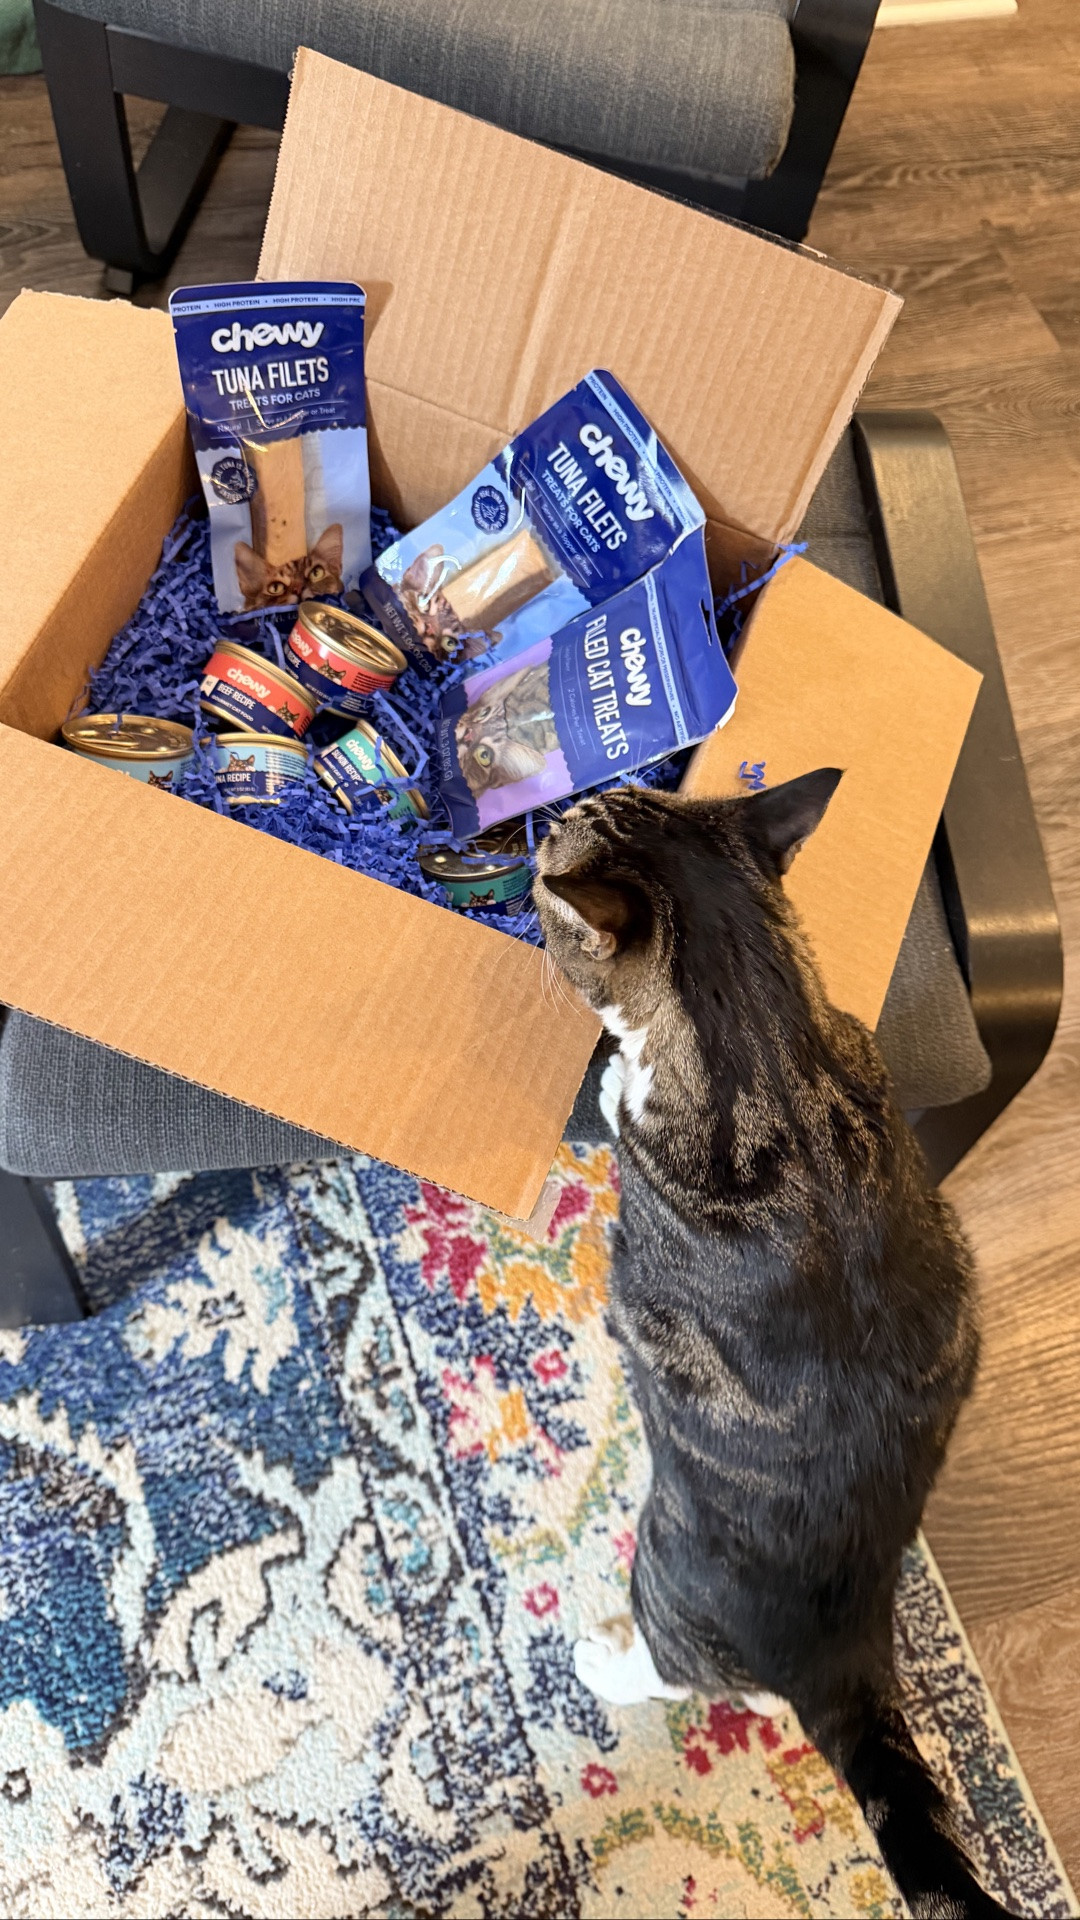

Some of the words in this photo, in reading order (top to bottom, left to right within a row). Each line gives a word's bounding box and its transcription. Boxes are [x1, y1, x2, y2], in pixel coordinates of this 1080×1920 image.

[173, 304, 201, 312] PROTEIN
[214, 300, 230, 308] HIGH
[231, 298, 260, 307] PROTEIN
[211, 320, 324, 353] chewy
[212, 362, 266, 396] TUNA
[268, 356, 330, 390] FILETS
[271, 392, 294, 405] FOR
[294, 388, 321, 401] CATS
[320, 406, 336, 414] Treat
[588, 376, 607, 400] PROTEIN
[613, 408, 625, 424] HIGH
[624, 422, 641, 448] PROTEIN
[580, 424, 654, 522] chewy
[542, 470, 570, 508] TREATS
[565, 504, 583, 529] FOR
[580, 526, 601, 553] CATS
[546, 442, 588, 498] TUNA
[576, 488, 628, 550] FILETS
[384, 602, 397, 618] NET
[587, 660, 614, 691] CAT
[620, 627, 652, 706] chewy
[217, 683, 235, 698] BEEF
[232, 689, 257, 710] RECIPE
[226, 668, 271, 699] chewy
[592, 690, 630, 760] TREATS
[331, 750, 349, 768] SALMON
[346, 740, 376, 770] chewy
[227, 773, 251, 783] RECIPE
